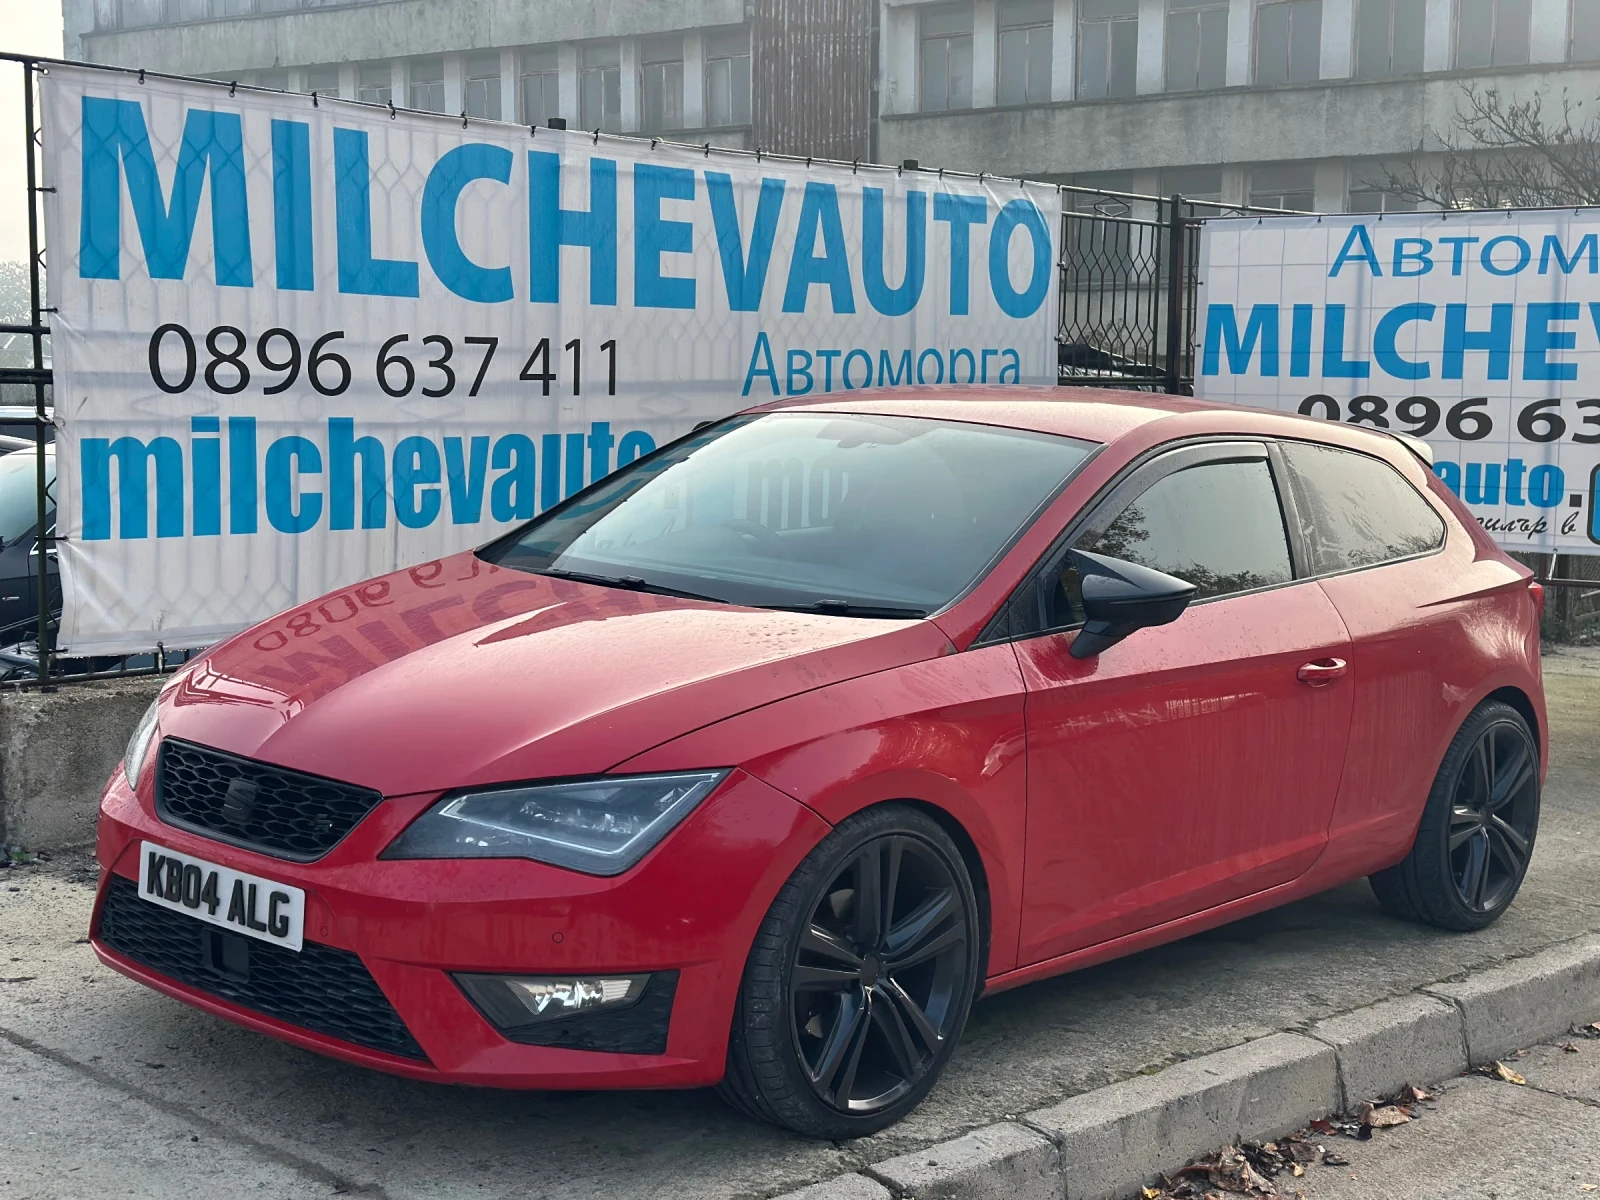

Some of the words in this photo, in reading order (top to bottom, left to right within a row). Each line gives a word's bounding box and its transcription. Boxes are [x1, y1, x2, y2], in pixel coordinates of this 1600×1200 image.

[79, 96, 1052, 320] MILCHEVAUTO
[148, 323, 351, 396] 0896
[375, 333, 498, 397] 637
[519, 337, 616, 397] 411
[1202, 302, 1600, 382] MILCHE
[147, 851, 220, 916] KB04
[227, 879, 291, 938] ALG
